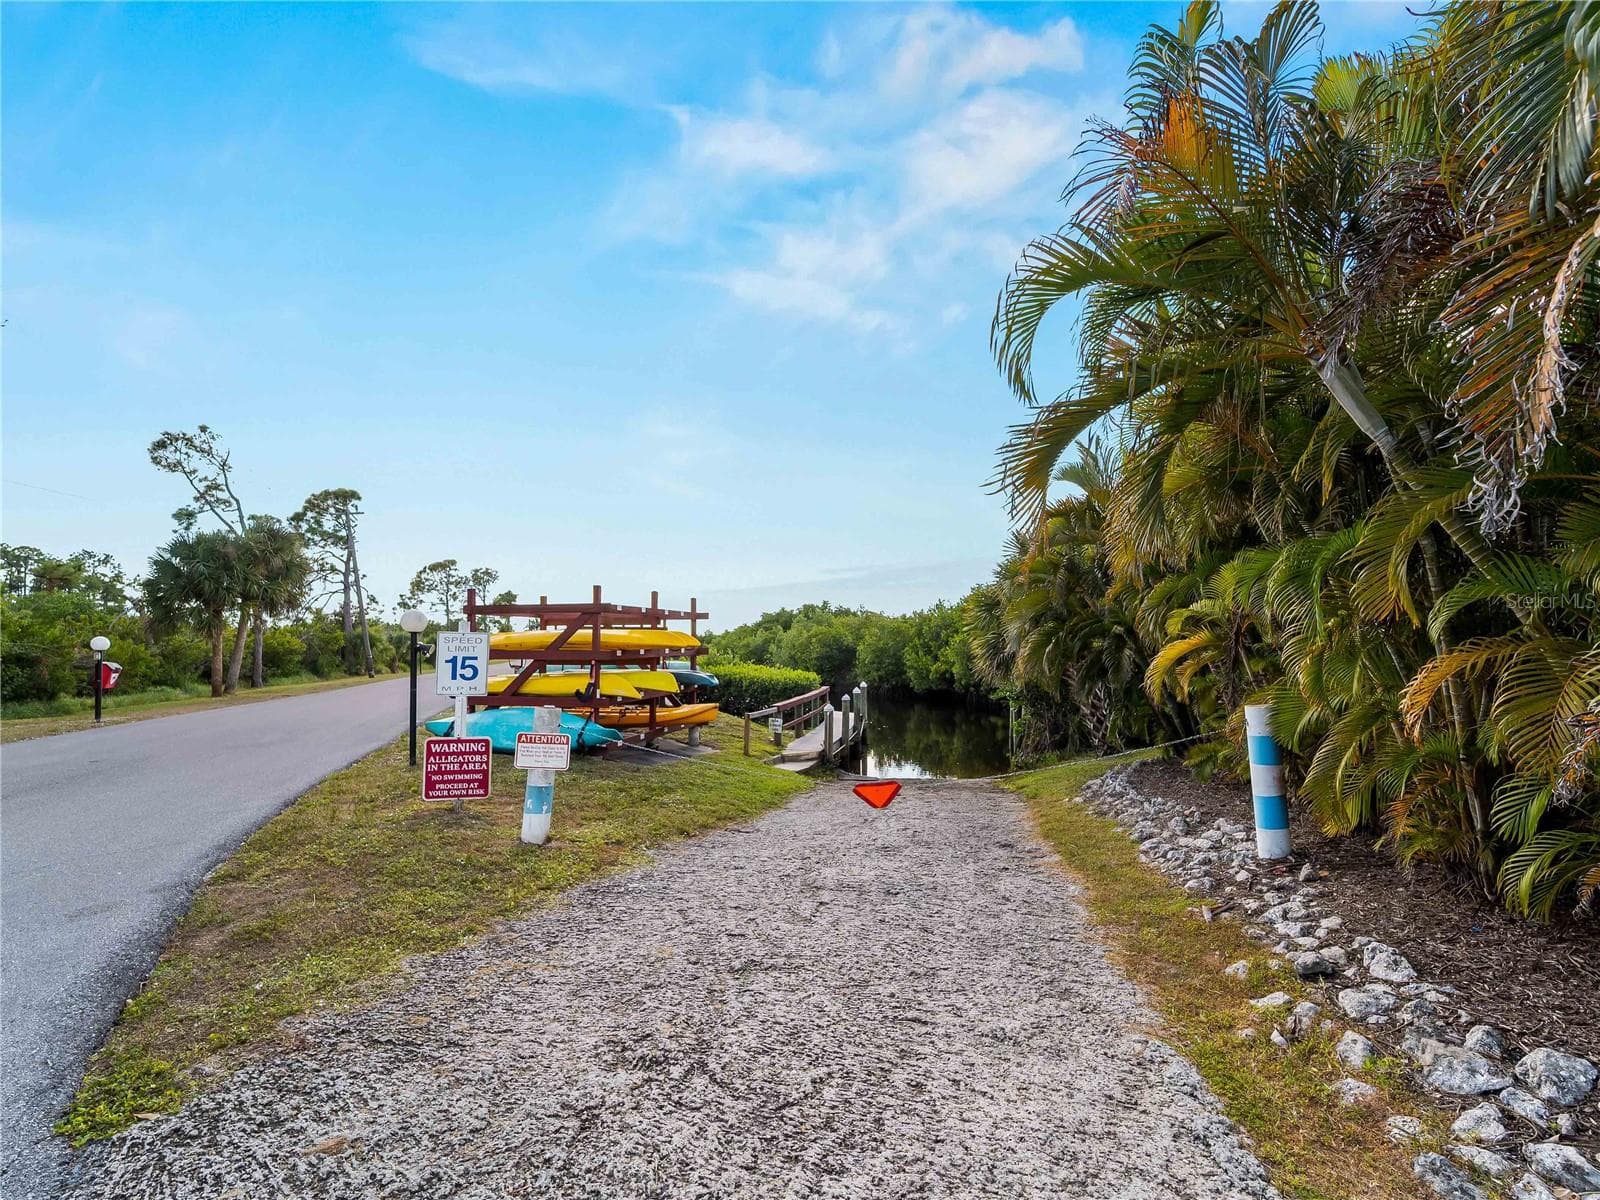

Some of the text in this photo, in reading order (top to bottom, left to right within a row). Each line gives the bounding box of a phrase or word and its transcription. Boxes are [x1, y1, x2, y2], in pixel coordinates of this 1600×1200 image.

[443, 636, 482, 645] SPEED
[445, 656, 479, 681] 15
[520, 735, 567, 744] ATTENTION
[430, 743, 486, 752] WARNING
[428, 754, 488, 763] ALLIGATORS
[440, 763, 460, 771] THE
[461, 762, 487, 770] AREA
